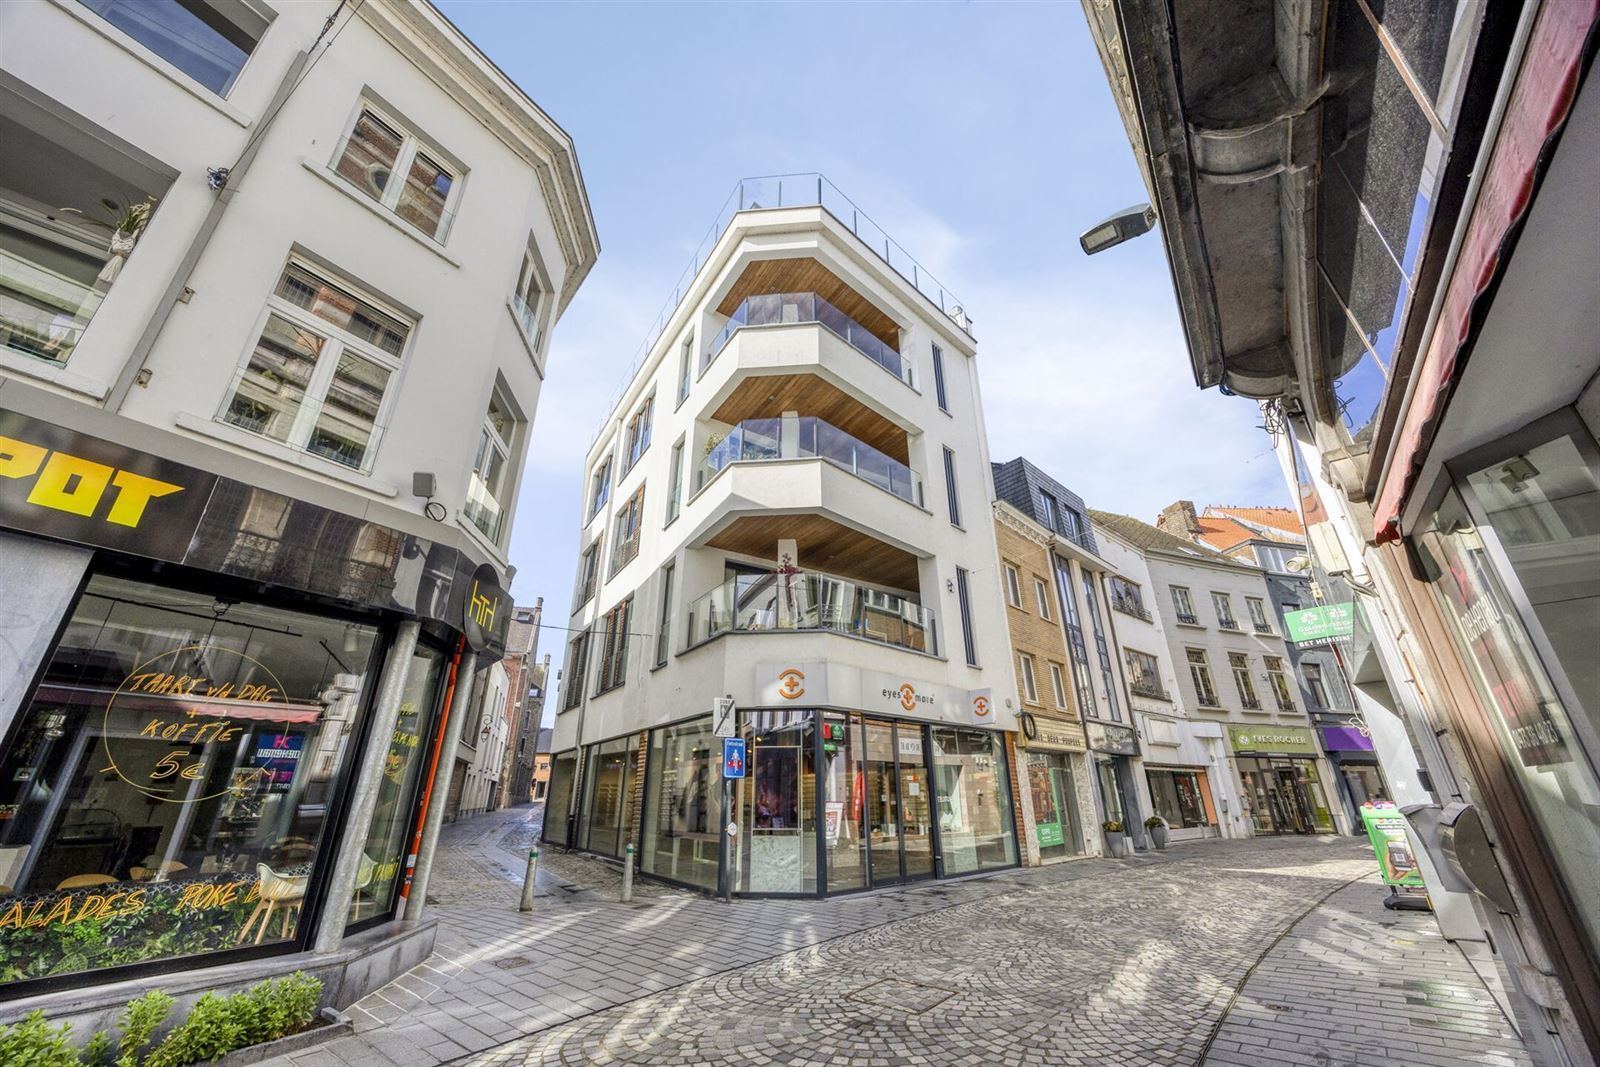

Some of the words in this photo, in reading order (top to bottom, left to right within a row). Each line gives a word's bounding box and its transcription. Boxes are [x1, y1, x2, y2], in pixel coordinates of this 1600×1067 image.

[130, 672, 206, 697] TAART
[237, 684, 279, 704] DAG
[882, 689, 901, 699] eyes
[914, 694, 934, 705] more
[140, 718, 243, 744] KOFFIE
[1252, 734, 1273, 744] YVES
[1273, 735, 1306, 745] ROCHER
[175, 879, 247, 912] POKE
